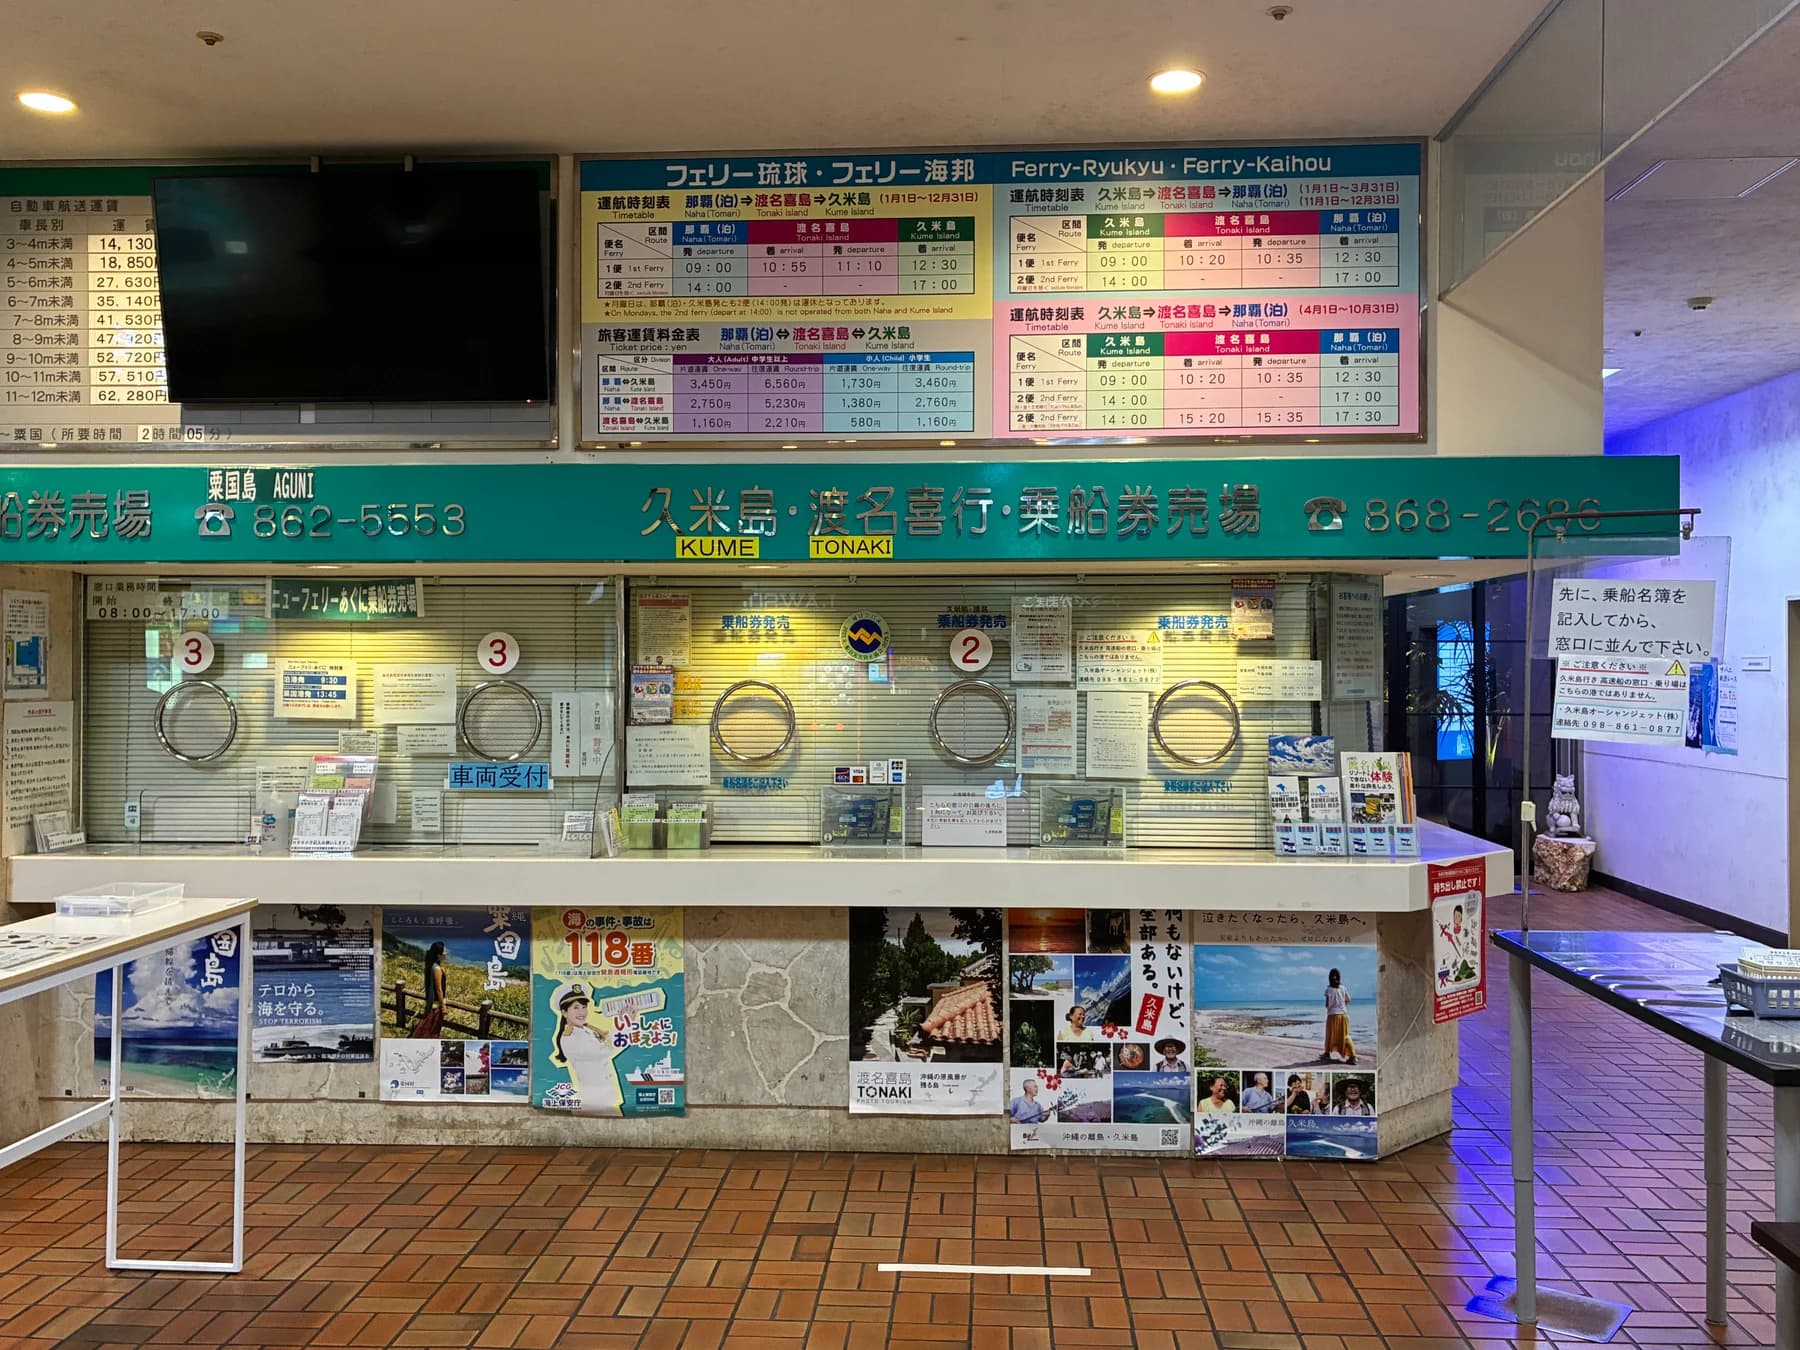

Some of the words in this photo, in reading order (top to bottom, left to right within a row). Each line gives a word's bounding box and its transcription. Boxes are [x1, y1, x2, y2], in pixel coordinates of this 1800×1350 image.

[1011, 158, 1164, 178] Ferry-Ryukyu
[1183, 155, 1332, 176] Ferry-Kaihou
[597, 195, 671, 210] 運航時刻表
[754, 193, 812, 208] 渡名喜島
[828, 192, 871, 206] 久米島
[1009, 188, 1085, 203] 運航時刻表
[1097, 187, 1141, 201] 久米島
[1157, 185, 1216, 200] 渡名喜島
[10, 199, 119, 212] 自動車航送運賃
[612, 211, 655, 219] Timetable
[757, 209, 783, 217] Tonaki
[785, 208, 809, 217] Island
[825, 208, 848, 216] Kume
[851, 207, 874, 216] Island
[19, 219, 64, 232] 車長別
[1009, 307, 1085, 322] 運航時刻表
[1097, 306, 1141, 320] 久米島
[1157, 305, 1216, 319] 渡名喜島
[598, 327, 700, 342] 旅客運賃料金表
[792, 327, 849, 341] 渡名喜島
[868, 326, 911, 340] 久米島
[1025, 323, 1069, 331] Timetable
[610, 343, 638, 351] Ticket
[640, 343, 663, 352] price
[850, 417, 881, 428] 580円
[208, 469, 256, 501] 粟国島
[273, 471, 314, 499] AGUNI
[253, 503, 466, 538] 862-5553
[1364, 497, 1601, 533] 868-2686
[680, 538, 756, 557] KUME
[811, 537, 893, 556] TONAKI
[1559, 587, 1688, 604] 先に、乗船名簿を
[721, 615, 790, 629] 乗船券発売
[937, 614, 1007, 628] 乗船券発売
[1157, 615, 1229, 629] 乗船券発売
[1557, 611, 1657, 629] 記入してから、
[184, 638, 202, 666] 3
[487, 637, 505, 667] 3
[962, 636, 980, 664] 2
[1555, 636, 1711, 657] 窓口に並んで下さい。
[450, 765, 548, 789] 車両受付
[1371, 770, 1393, 783] 体験
[565, 931, 654, 966] 118番
[258, 983, 316, 998] テロから
[257, 1001, 324, 1016] 海を守る。
[1141, 998, 1157, 1031] 久米島
[613, 1014, 672, 1031] いっしょに
[857, 1071, 912, 1085] 渡名喜島
[857, 1086, 912, 1098] TONAKI
[544, 1098, 582, 1107] 海上保安庁
